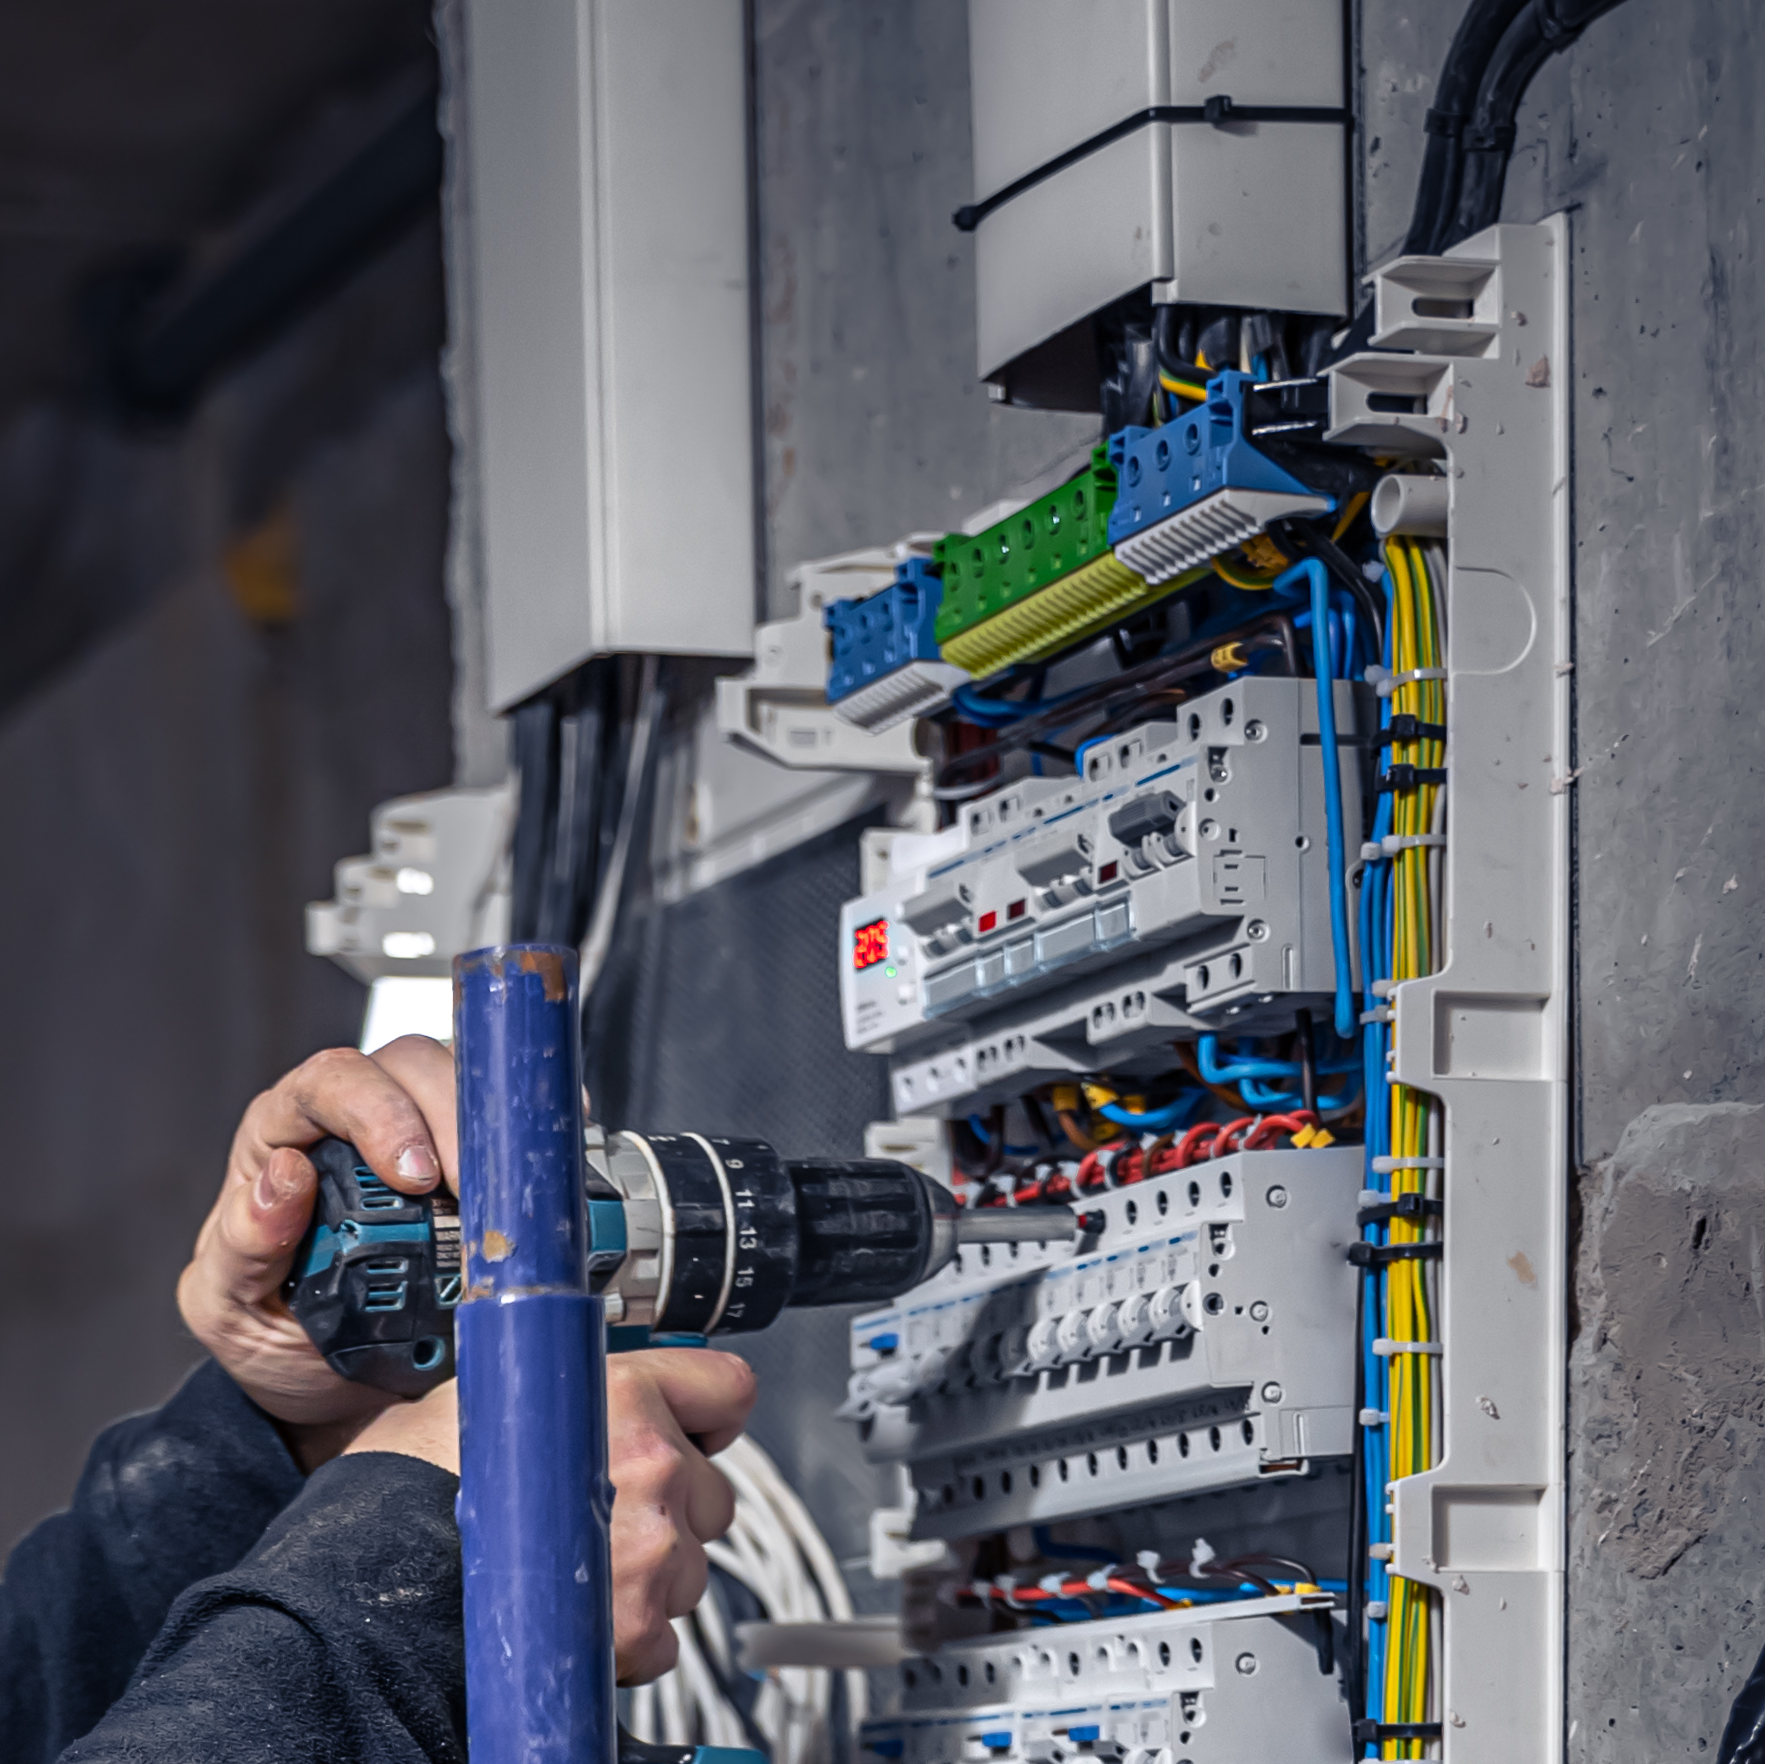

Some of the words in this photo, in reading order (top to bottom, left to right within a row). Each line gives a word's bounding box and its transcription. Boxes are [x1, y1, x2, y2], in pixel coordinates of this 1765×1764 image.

[735, 1188, 756, 1208] 11
[739, 1226, 758, 1250] 13
[735, 1266, 755, 1288] 15
